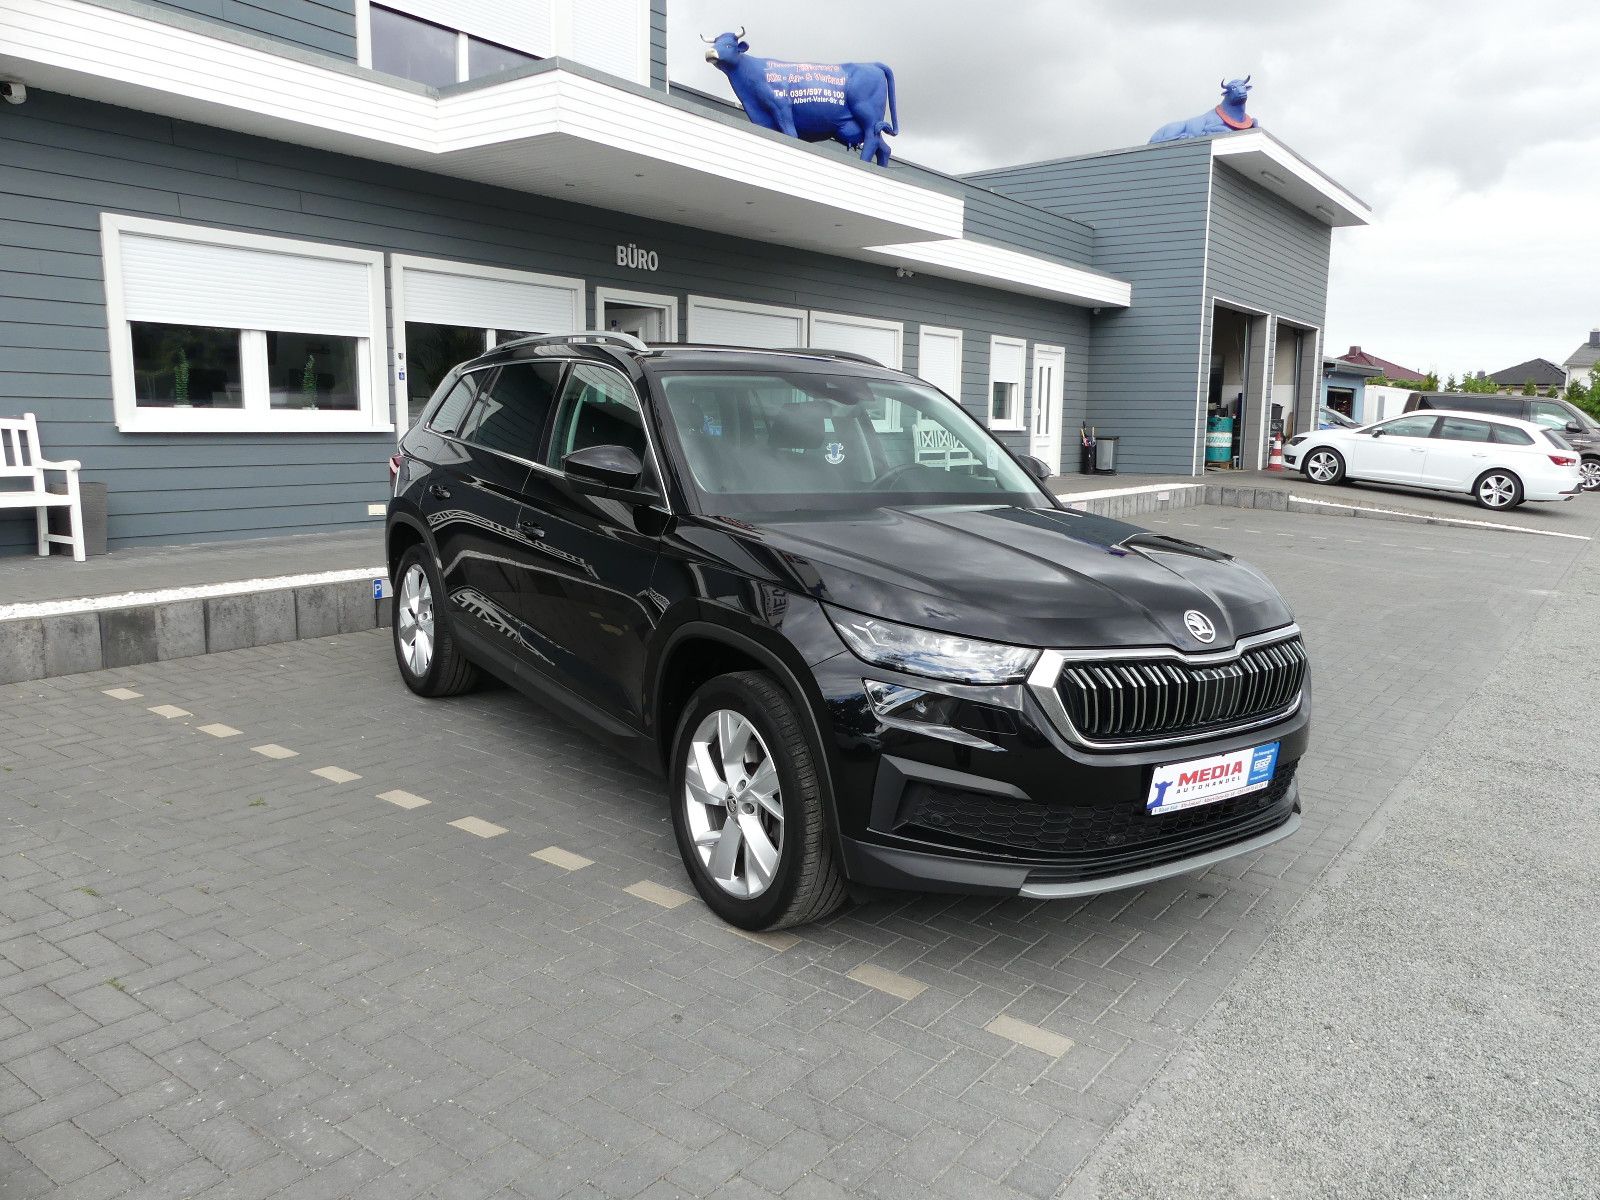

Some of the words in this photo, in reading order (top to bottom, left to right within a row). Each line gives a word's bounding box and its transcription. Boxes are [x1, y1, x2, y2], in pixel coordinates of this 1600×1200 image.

[616, 243, 659, 272] BÜRO
[374, 583, 382, 595] P
[1175, 775, 1241, 795] AUTOHANDEL
[1177, 760, 1243, 787] MEDIA
